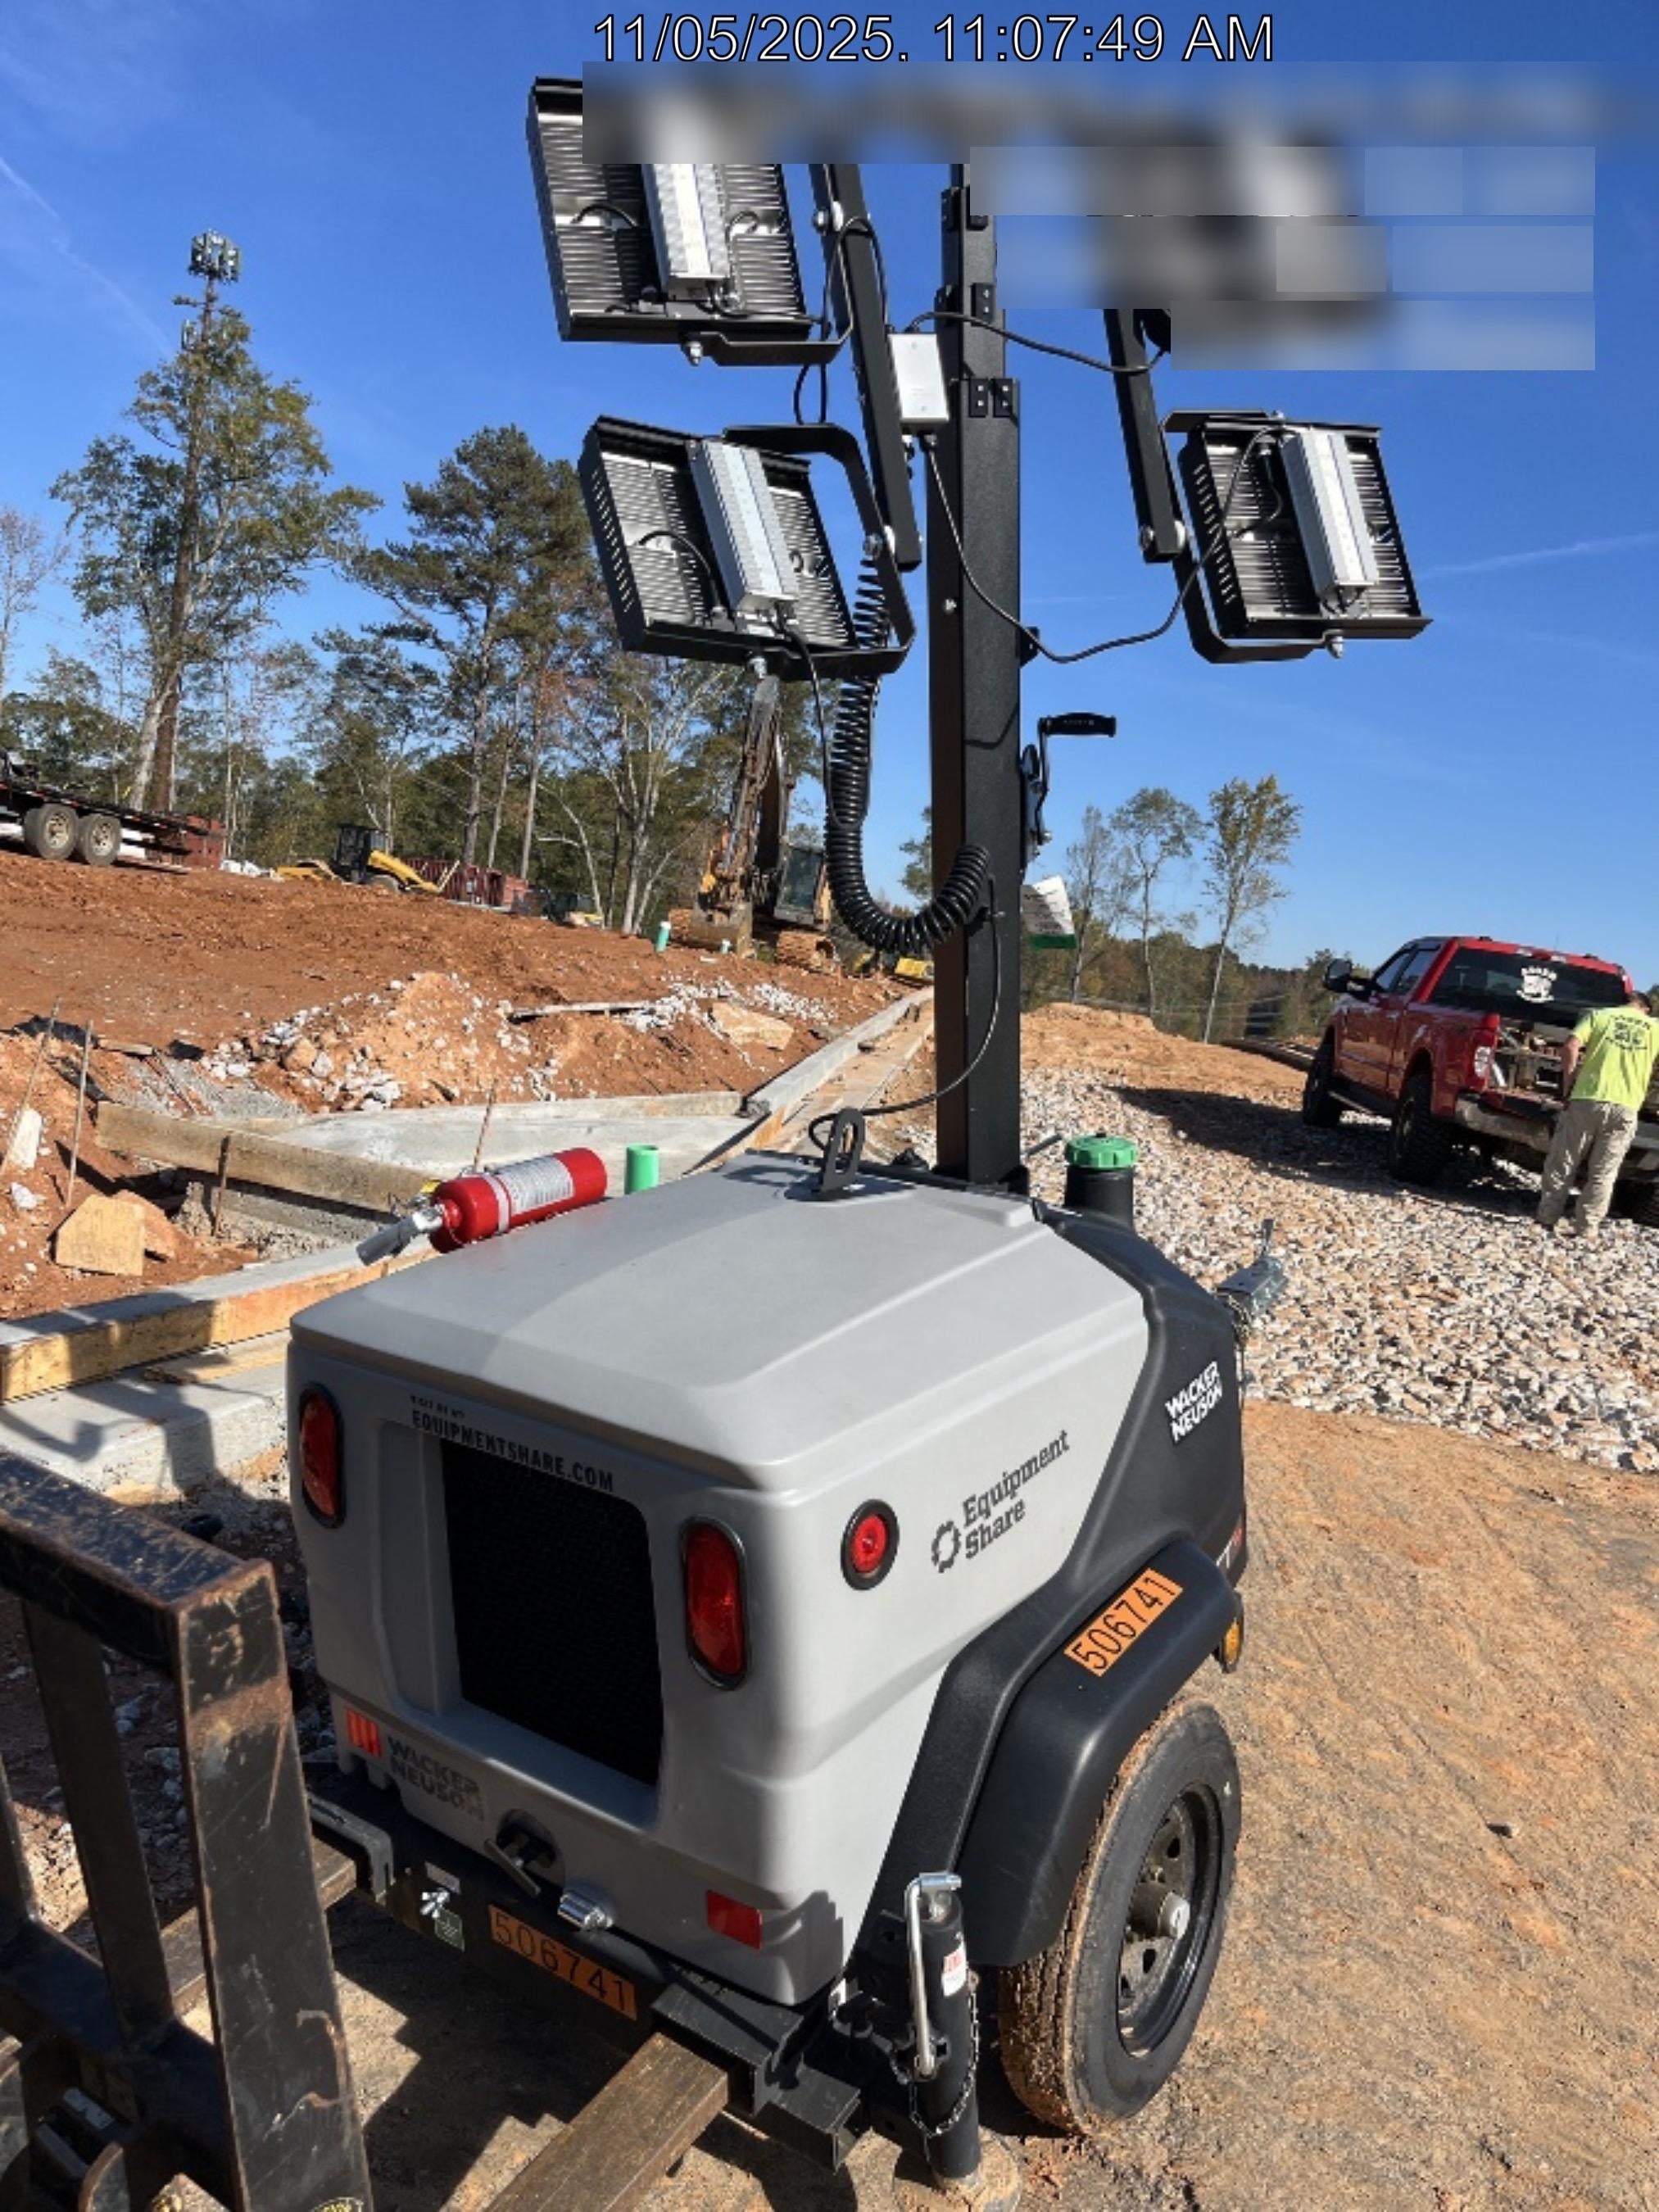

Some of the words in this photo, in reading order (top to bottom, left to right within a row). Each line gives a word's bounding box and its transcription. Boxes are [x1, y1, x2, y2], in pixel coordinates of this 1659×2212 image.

[1165, 1361, 1220, 1418] WACKER
[412, 1410, 614, 1493] EQUIPMENTSHARE.COM
[963, 1430, 1070, 1529] Equipment
[965, 1499, 1026, 1559] Share
[1072, 1576, 1176, 1670] 506741
[495, 1911, 626, 2011] 506741
